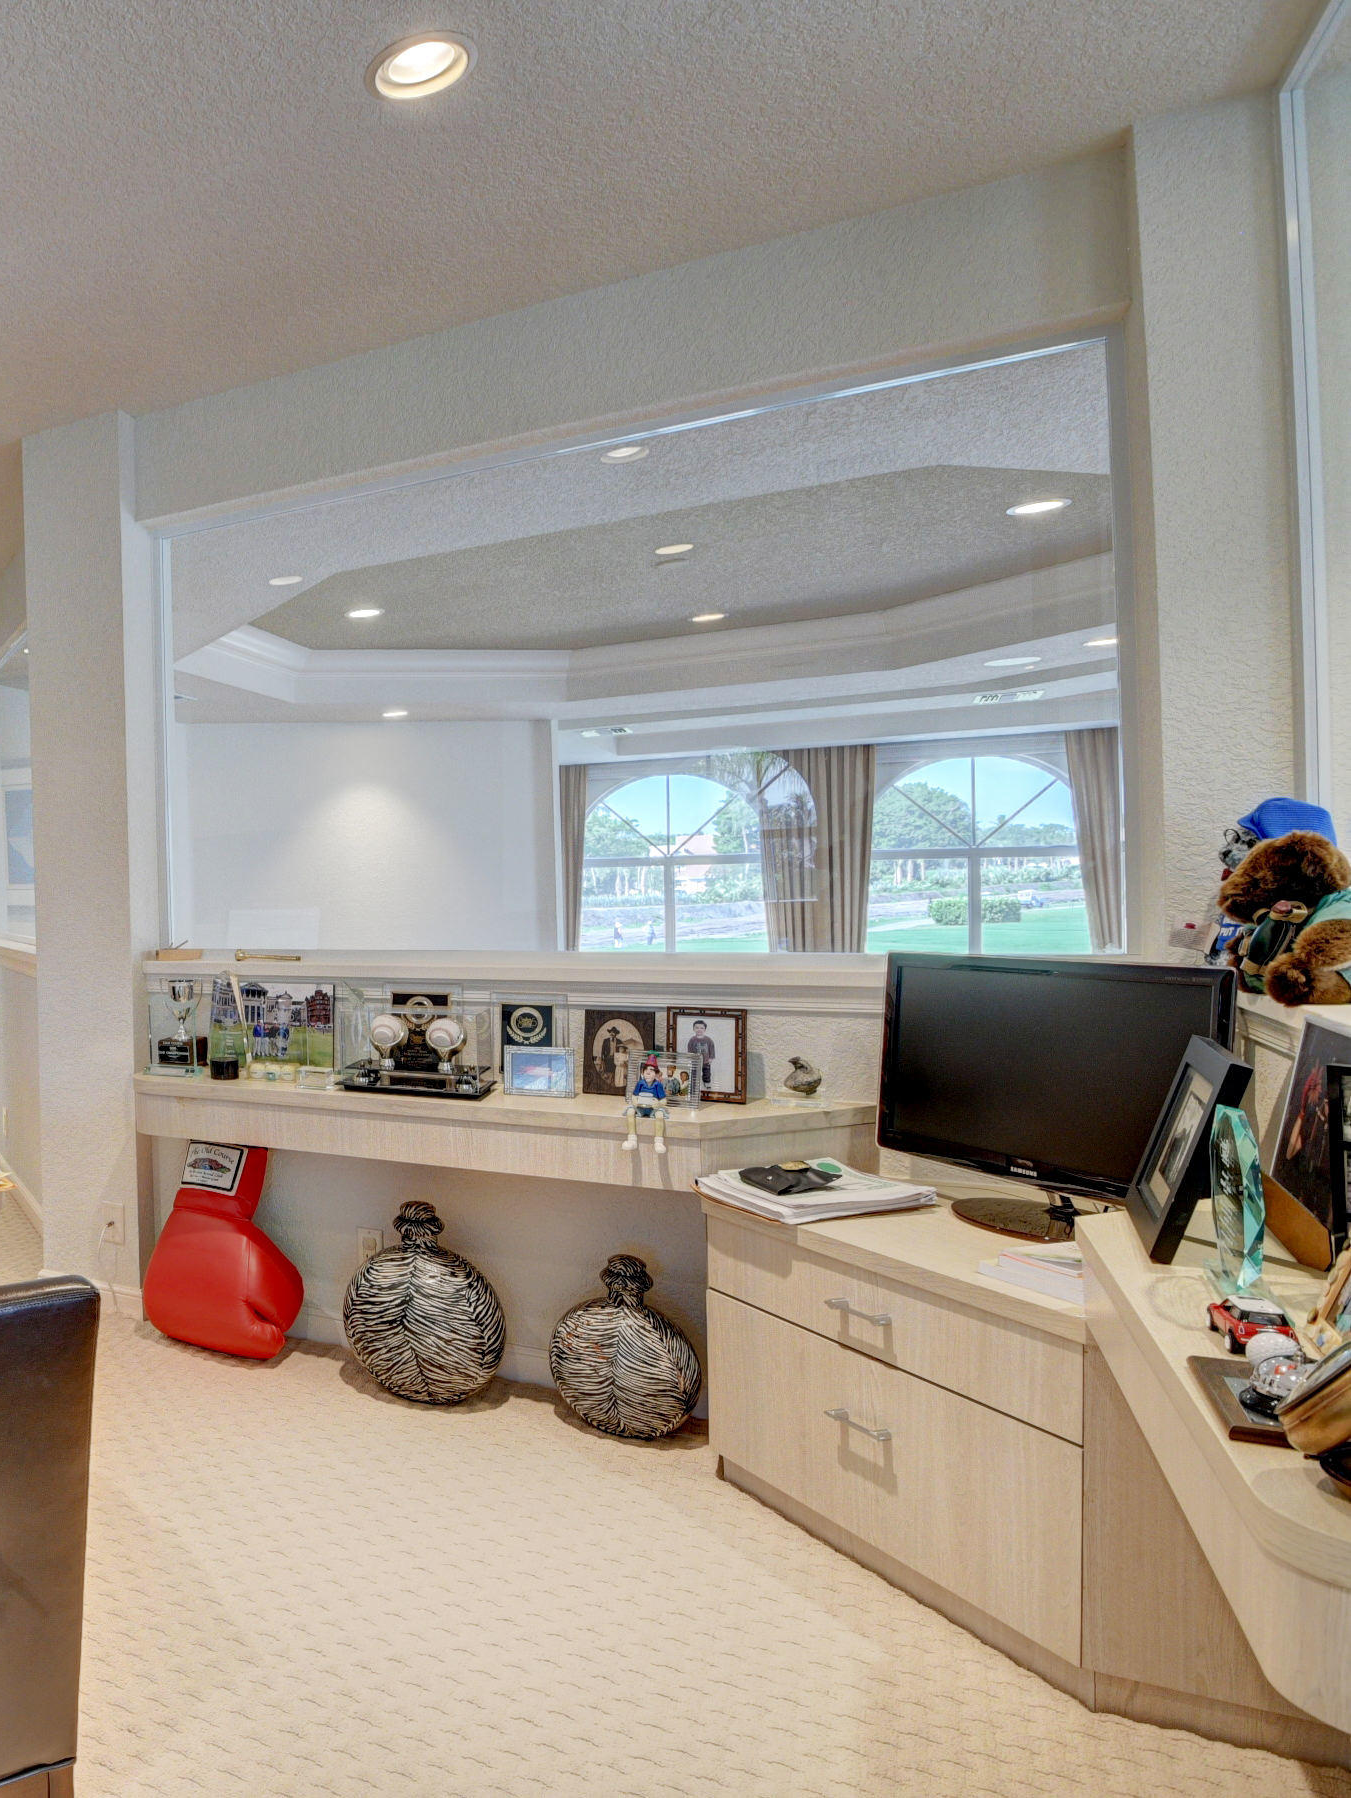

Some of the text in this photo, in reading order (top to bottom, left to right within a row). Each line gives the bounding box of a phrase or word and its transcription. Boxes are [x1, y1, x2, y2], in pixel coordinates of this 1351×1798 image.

[1219, 927, 1235, 937] PUT
[201, 1146, 214, 1154] Old
[213, 1149, 234, 1164] Course
[1010, 1166, 1037, 1177] SAMSUNG
